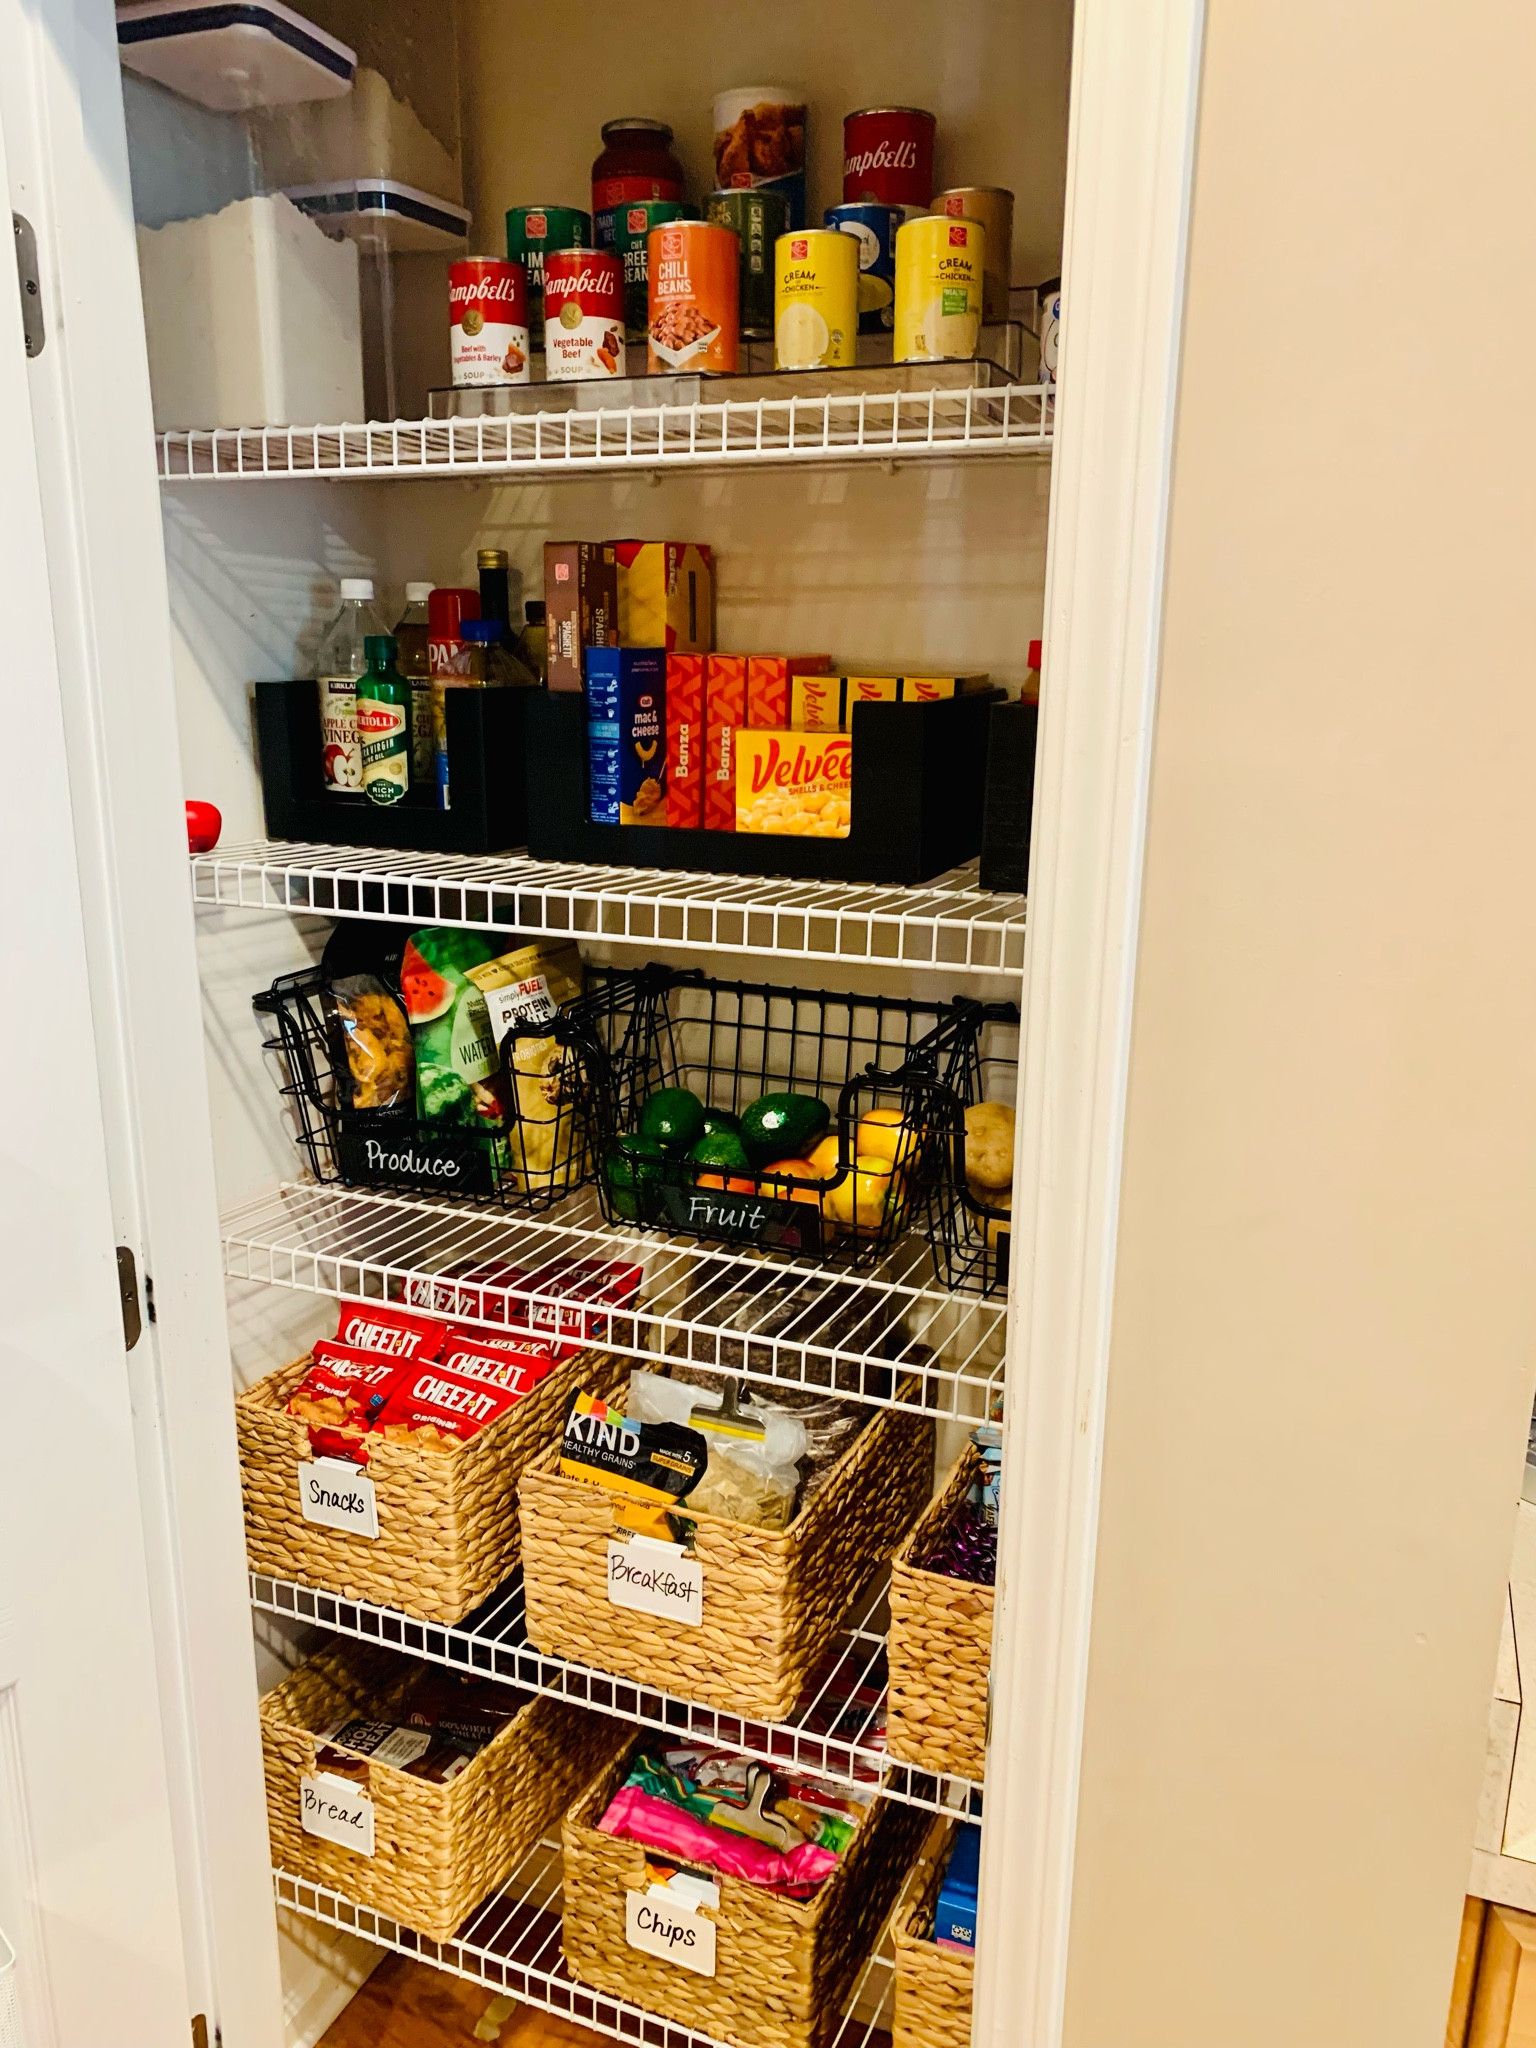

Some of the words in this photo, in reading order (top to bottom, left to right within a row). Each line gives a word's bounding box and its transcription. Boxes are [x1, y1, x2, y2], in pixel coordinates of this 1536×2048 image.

[844, 140, 917, 177] ampbell's
[658, 260, 688, 280] CHILI
[939, 258, 972, 272] CREAM
[784, 269, 816, 284] CREAM
[939, 272, 971, 282] CHICKEN
[449, 275, 515, 306] ampbell's
[657, 279, 692, 296] BEANS
[785, 284, 815, 294] CHICKEN
[552, 337, 594, 349] Vegetable
[562, 349, 582, 359] Beef
[463, 371, 485, 380] SOUP
[560, 365, 583, 374] SOUP
[595, 607, 605, 648] SPAGH
[561, 620, 573, 658] SPAGHETTI
[634, 712, 652, 725] mac
[369, 738, 395, 754] VIRGIN
[675, 723, 689, 778] Banza
[716, 726, 731, 781] Banza
[374, 752, 385, 761] OIL
[372, 785, 394, 794] RICH
[788, 786, 817, 796] SHELLS
[819, 784, 825, 792] &
[501, 995, 552, 1024] PROTEIN
[365, 1139, 461, 1177] Produce
[689, 1197, 765, 1229] Fruit
[564, 1410, 641, 1458] KIND
[562, 1439, 601, 1460] HEALTHY
[682, 1450, 692, 1463] 5
[652, 1454, 671, 1466] SUPER
[670, 1459, 695, 1474] GRAINS
[309, 1479, 365, 1513] Snacks
[611, 1554, 698, 1602] Breakfast
[303, 1788, 363, 1829] Bread
[637, 1906, 697, 1949] Chips
